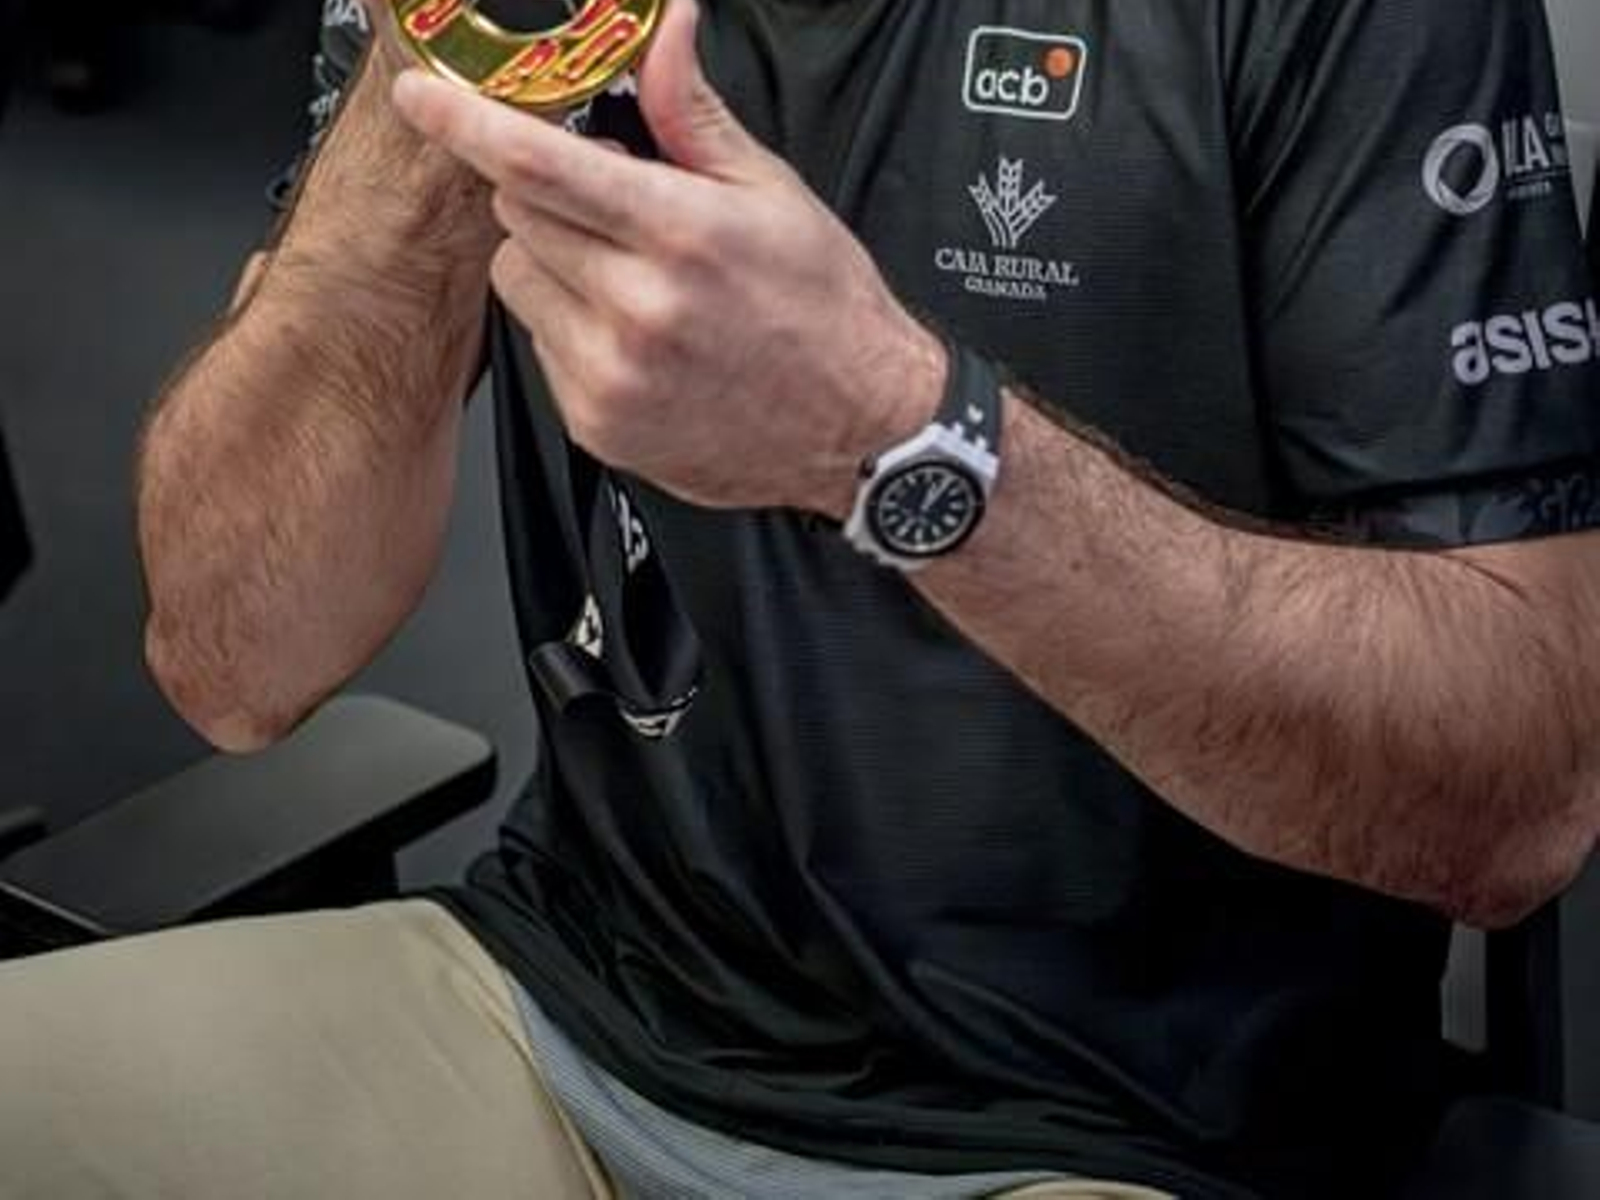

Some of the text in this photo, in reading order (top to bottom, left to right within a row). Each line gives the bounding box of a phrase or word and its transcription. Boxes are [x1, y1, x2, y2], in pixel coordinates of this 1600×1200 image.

[975, 66, 1049, 105] acb
[934, 248, 1080, 286] CAJA RURAL
[964, 275, 1047, 300] GRANADA
[1451, 297, 1600, 385] asis
